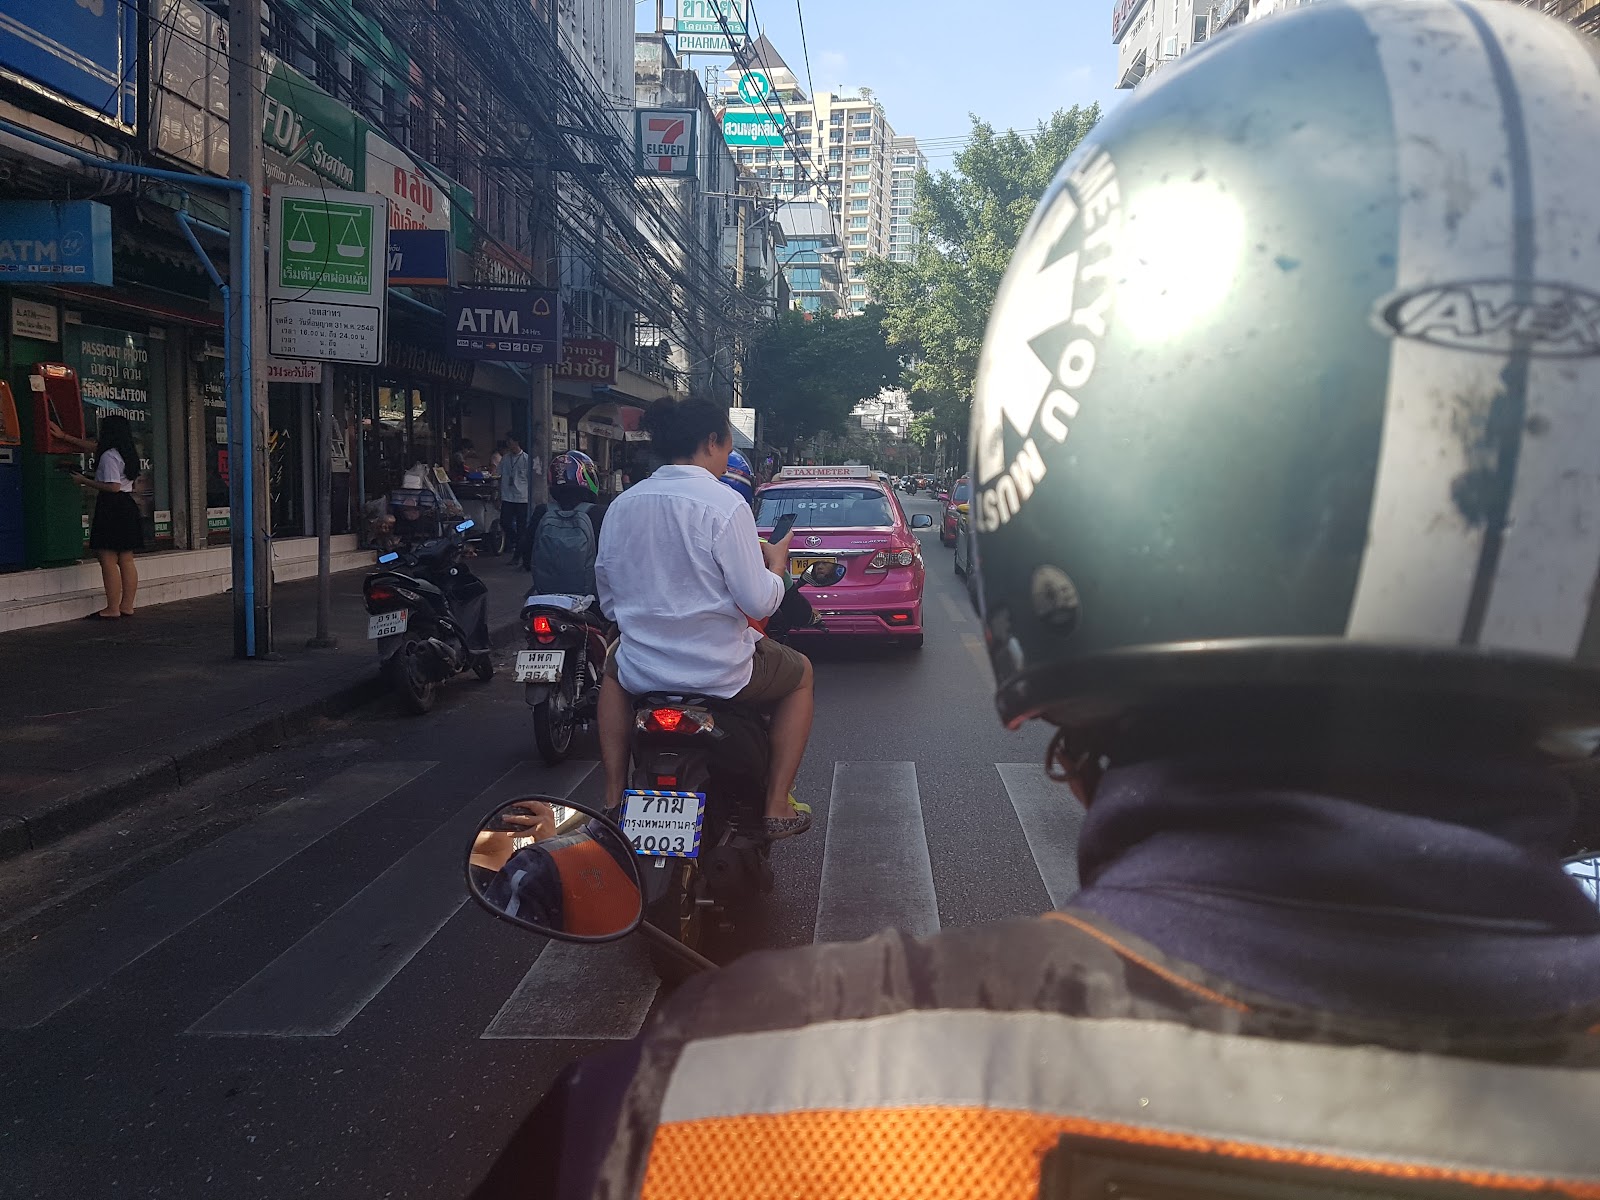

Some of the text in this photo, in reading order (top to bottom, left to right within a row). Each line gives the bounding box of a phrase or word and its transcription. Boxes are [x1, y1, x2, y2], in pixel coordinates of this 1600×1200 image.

[680, 37, 743, 49] PHARMAY
[648, 118, 684, 171] 7
[0, 239, 57, 262] ATM
[456, 308, 519, 334] ATM
[81, 340, 148, 363] PASSPORT PHOTO
[625, 819, 697, 831] กรุงเทพมหานคร
[631, 835, 685, 853] 4003
